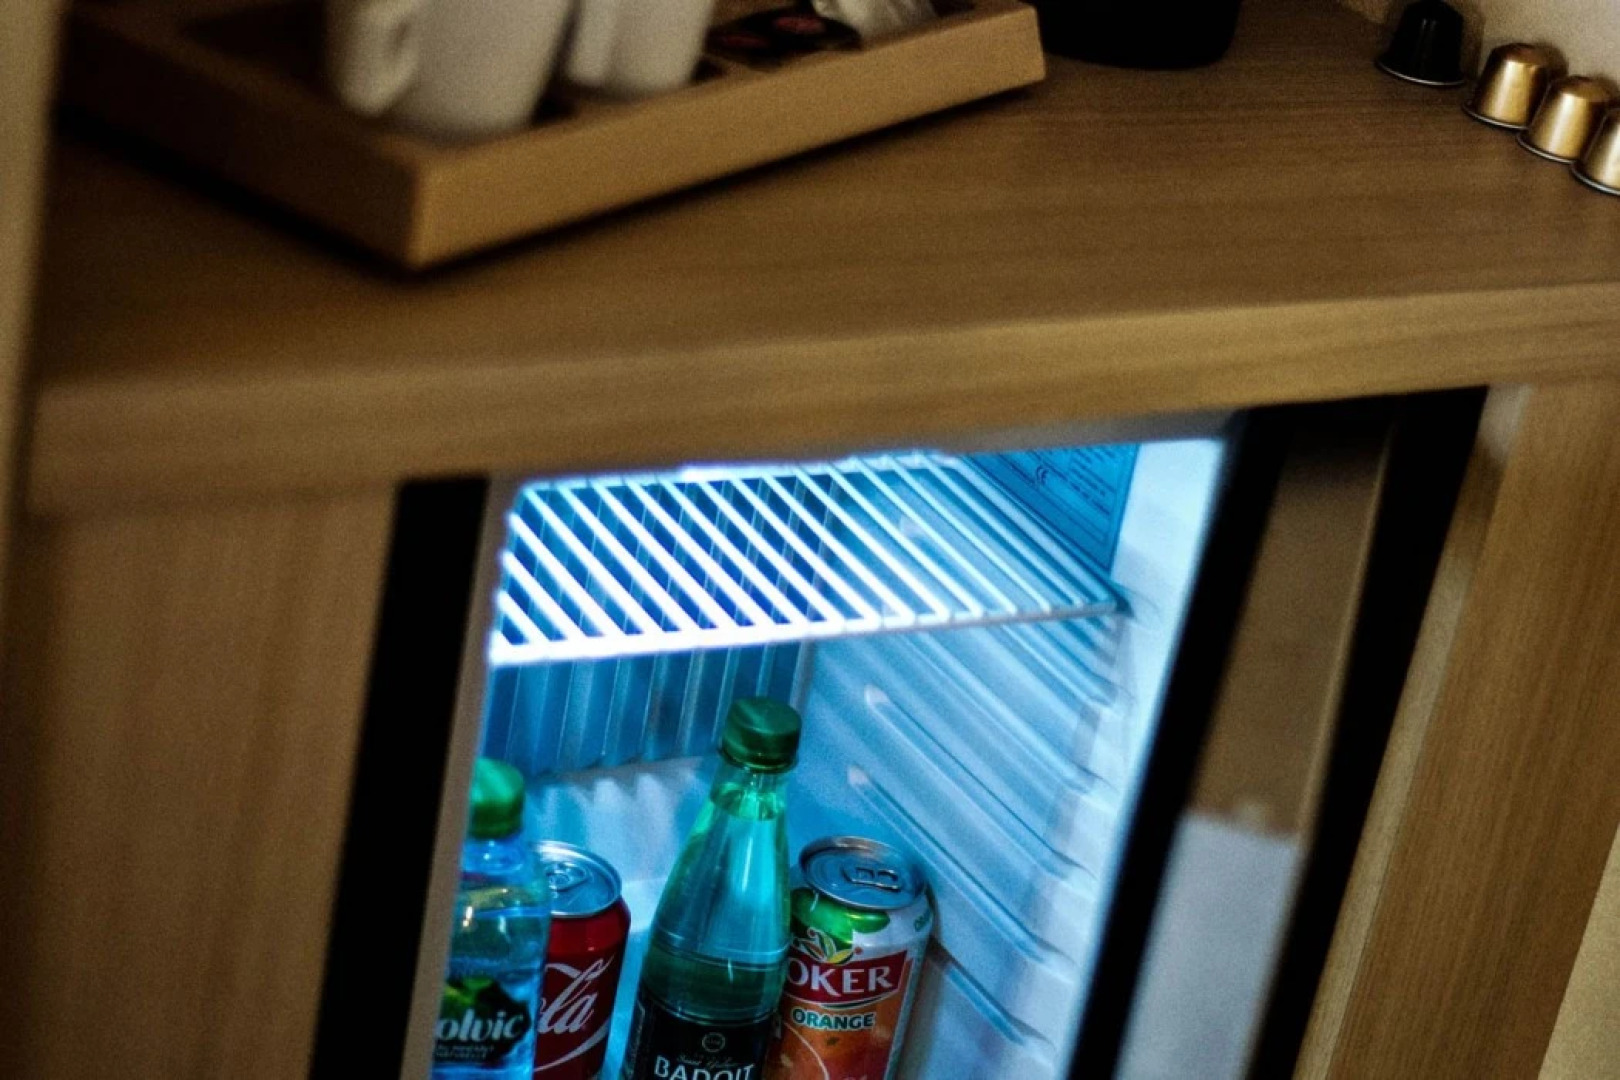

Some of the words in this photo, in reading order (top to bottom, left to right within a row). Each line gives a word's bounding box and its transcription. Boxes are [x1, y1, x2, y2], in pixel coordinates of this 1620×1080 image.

[787, 958, 892, 997] OKER
[537, 957, 605, 1035] la
[435, 1008, 524, 1041] olvic
[792, 1007, 875, 1029] ORANGE
